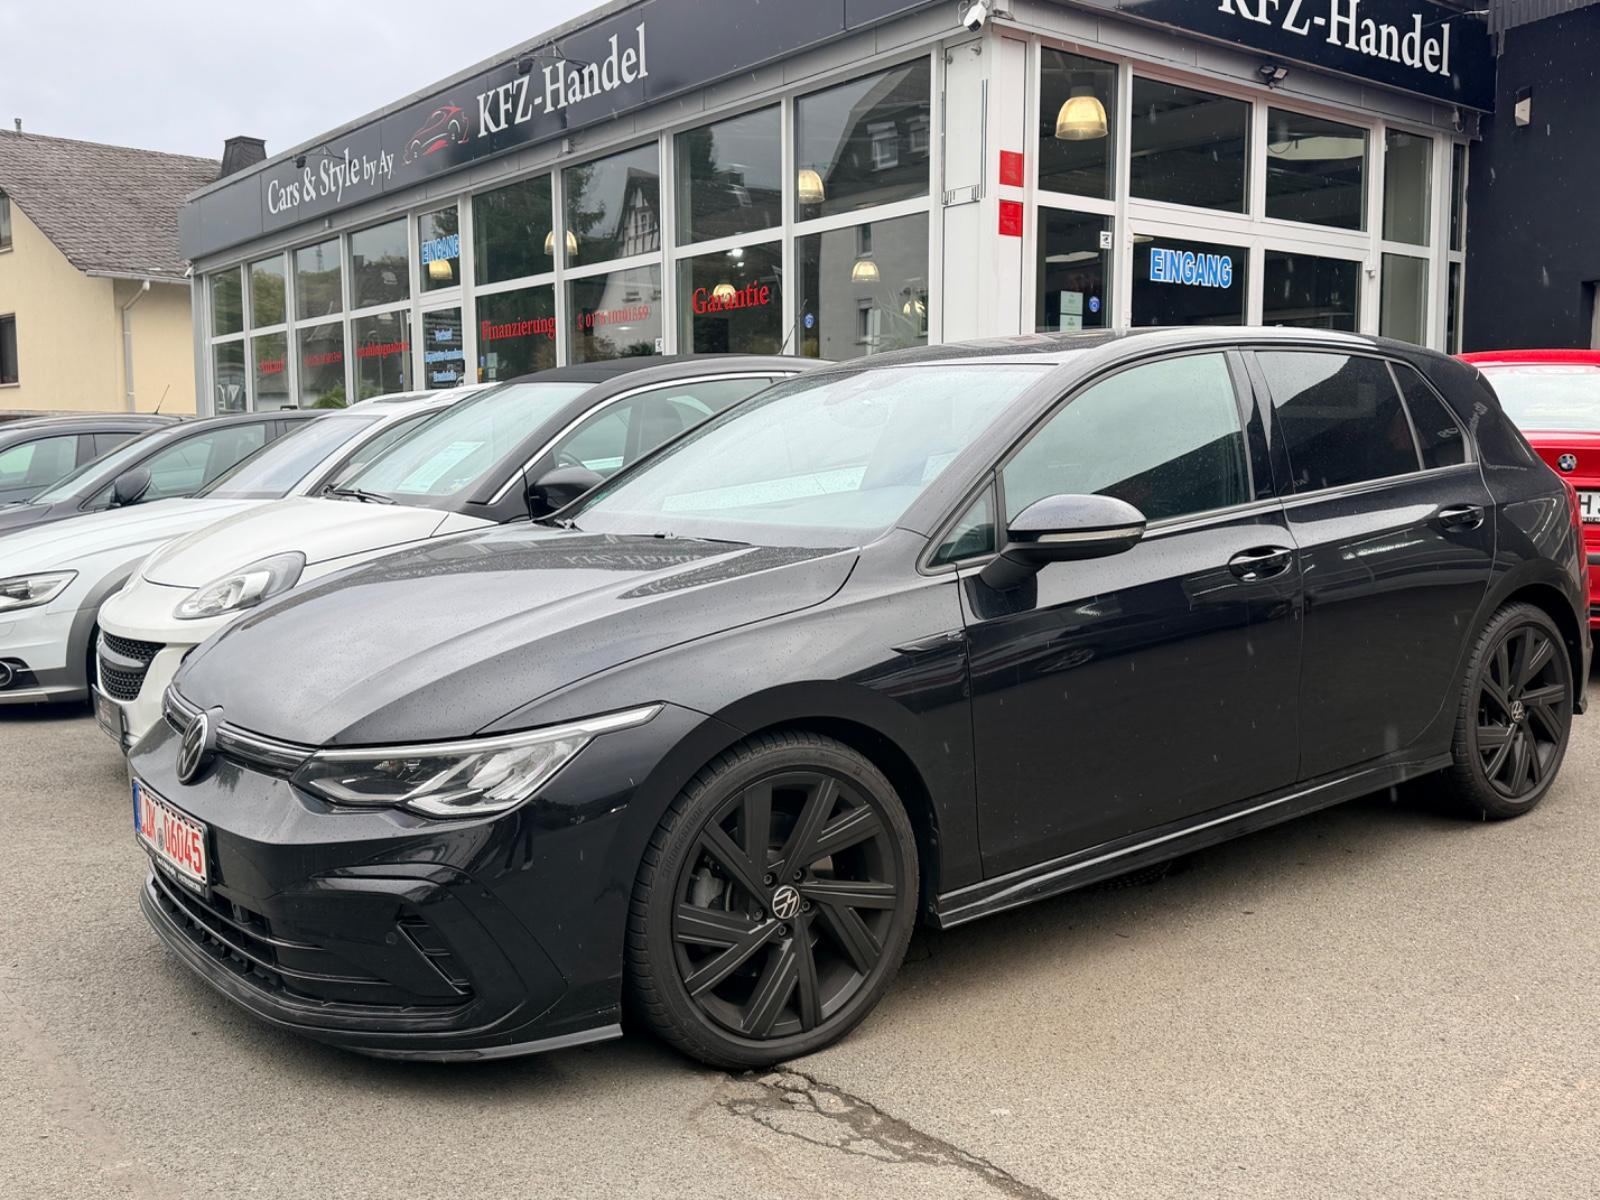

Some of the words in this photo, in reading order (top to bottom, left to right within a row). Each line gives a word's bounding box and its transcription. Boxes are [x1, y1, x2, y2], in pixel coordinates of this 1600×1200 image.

[1218, 0, 1451, 77] Z-Handel
[477, 22, 648, 138] KFZ-Handel
[268, 179, 300, 214] Cars
[303, 167, 316, 202] &
[320, 147, 360, 203] Style
[363, 155, 377, 185] by
[378, 149, 394, 180] Ay
[692, 280, 769, 314] Garantie
[1150, 247, 1233, 289] EINGANG
[481, 316, 556, 341] Finanzierung
[163, 814, 203, 874] 06045
